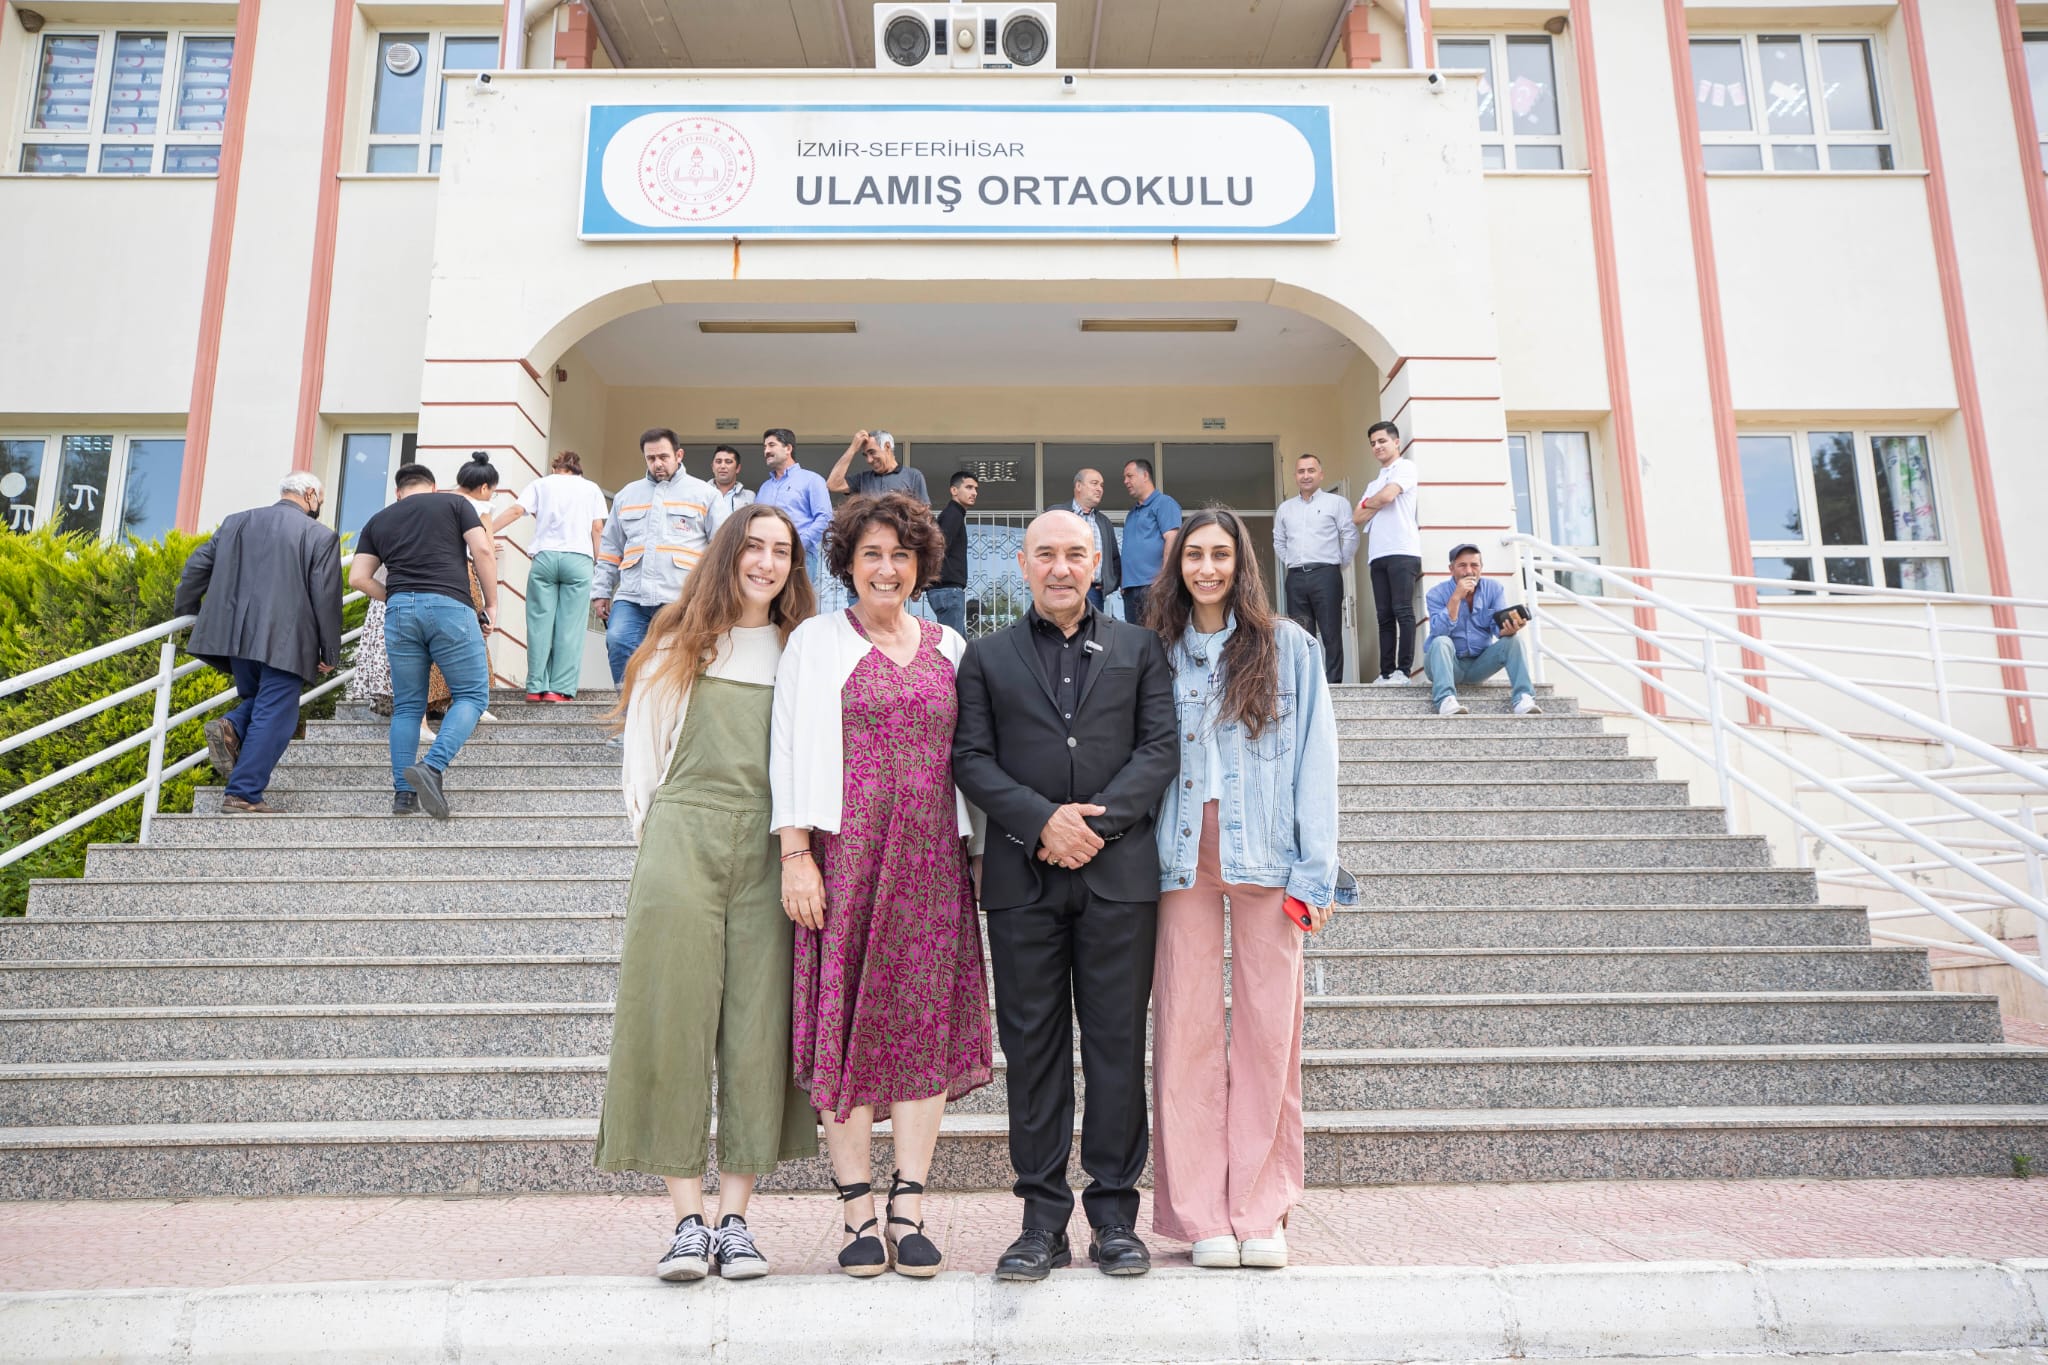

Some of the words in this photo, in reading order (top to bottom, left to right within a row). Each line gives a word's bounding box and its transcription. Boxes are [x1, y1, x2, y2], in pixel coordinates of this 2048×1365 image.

[797, 139, 1025, 158] İZMİR-SEFERİHİSAR
[796, 175, 962, 213] ULAMIŞ
[977, 175, 1253, 207] ORTAOKULU
